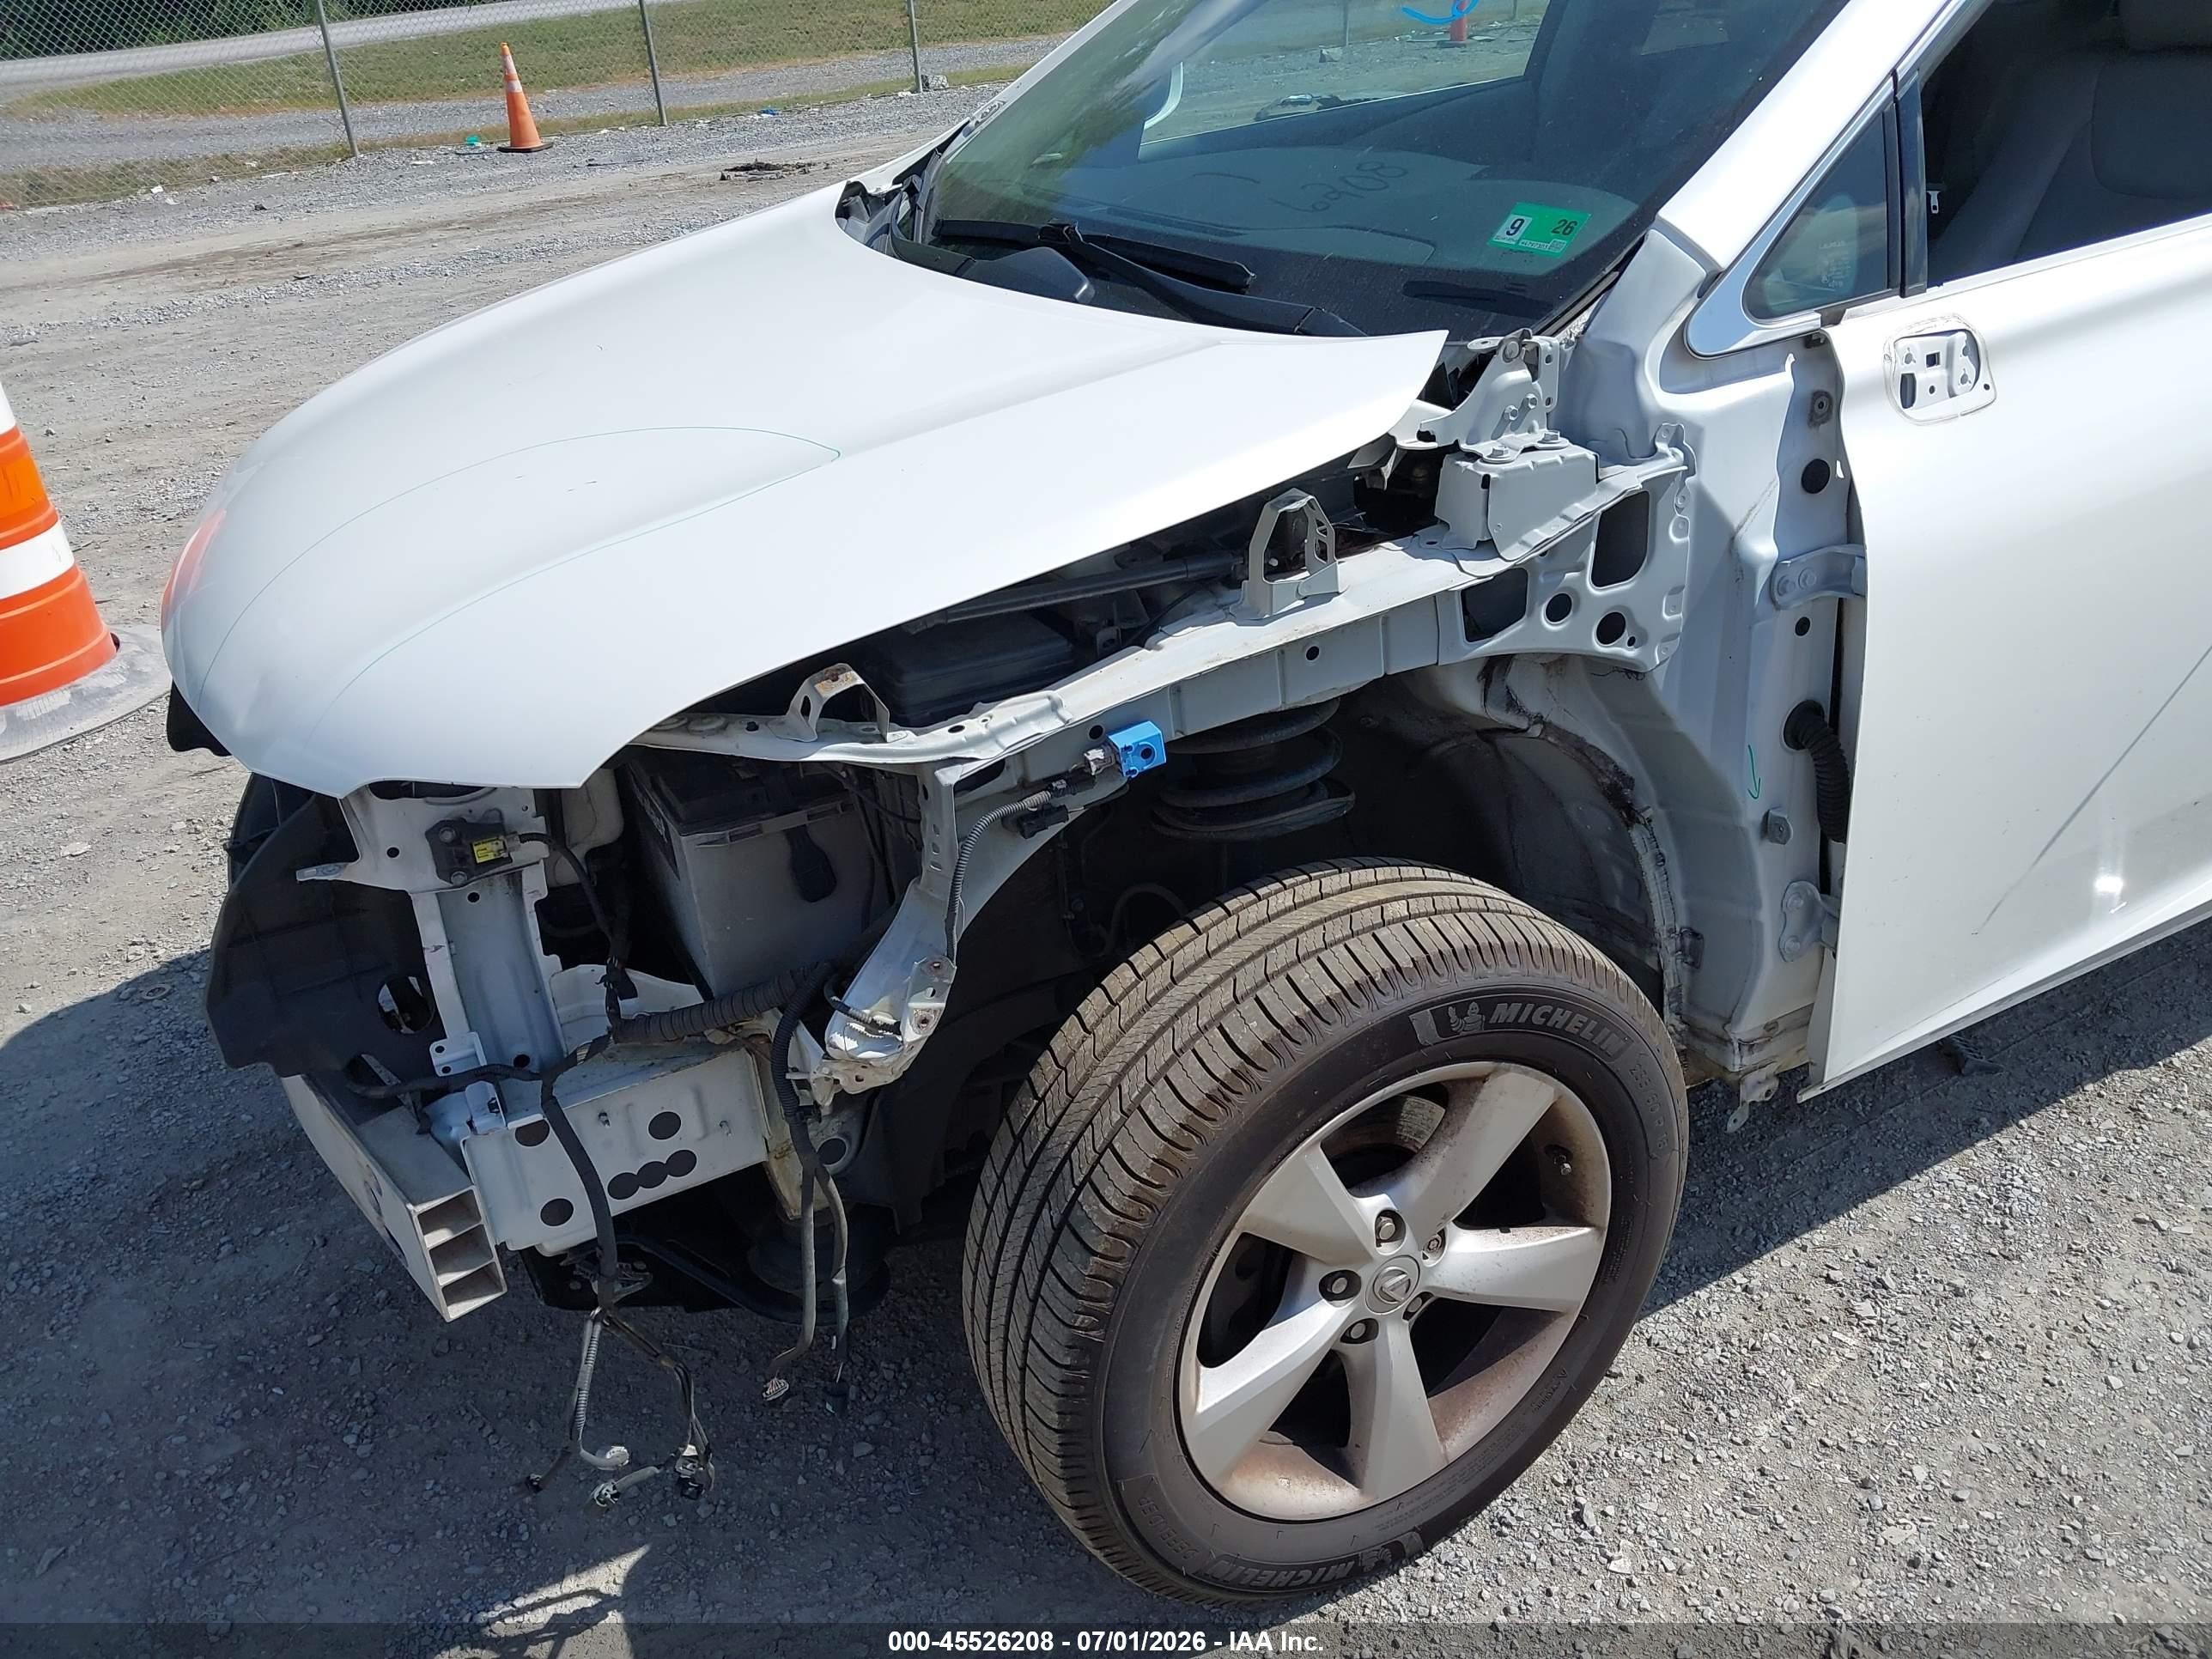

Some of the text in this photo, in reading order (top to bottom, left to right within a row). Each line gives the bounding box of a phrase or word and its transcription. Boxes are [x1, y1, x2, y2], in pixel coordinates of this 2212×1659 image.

[1506, 218, 1525, 236] 9
[1551, 219, 1578, 236] 26
[1489, 1003, 1629, 1057] MICHELIN
[1204, 1560, 1355, 1588] MICHELIN
